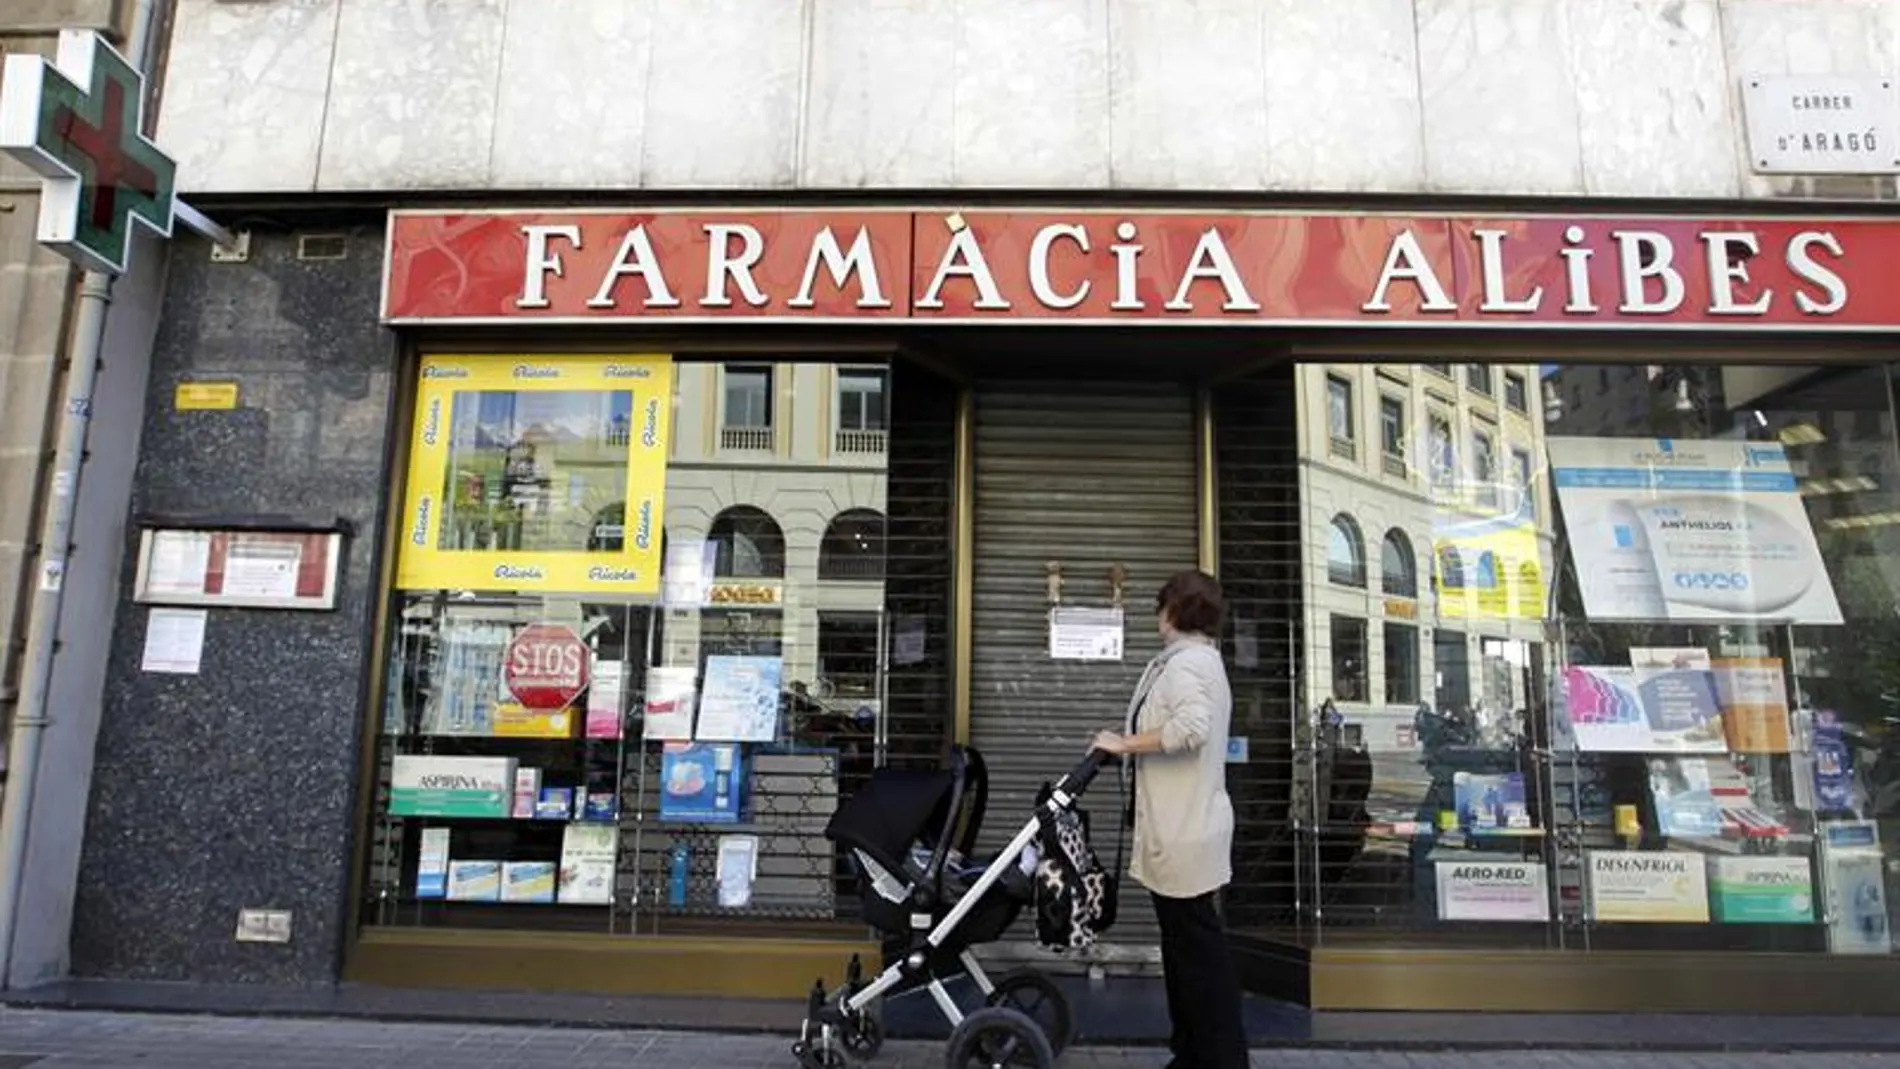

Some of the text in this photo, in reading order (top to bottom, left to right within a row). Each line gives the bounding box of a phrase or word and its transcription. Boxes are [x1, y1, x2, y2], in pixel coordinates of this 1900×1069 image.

[1792, 96, 1852, 110] CARRER
[513, 366, 559, 378] Ricola
[603, 365, 651, 378] Ricola
[642, 399, 658, 448] Ricola
[635, 499, 651, 550] Ricola
[494, 564, 542, 579] Ricola
[588, 566, 637, 580] Ricola
[511, 642, 582, 676] STOS
[1452, 866, 1527, 880] AERO-RED
